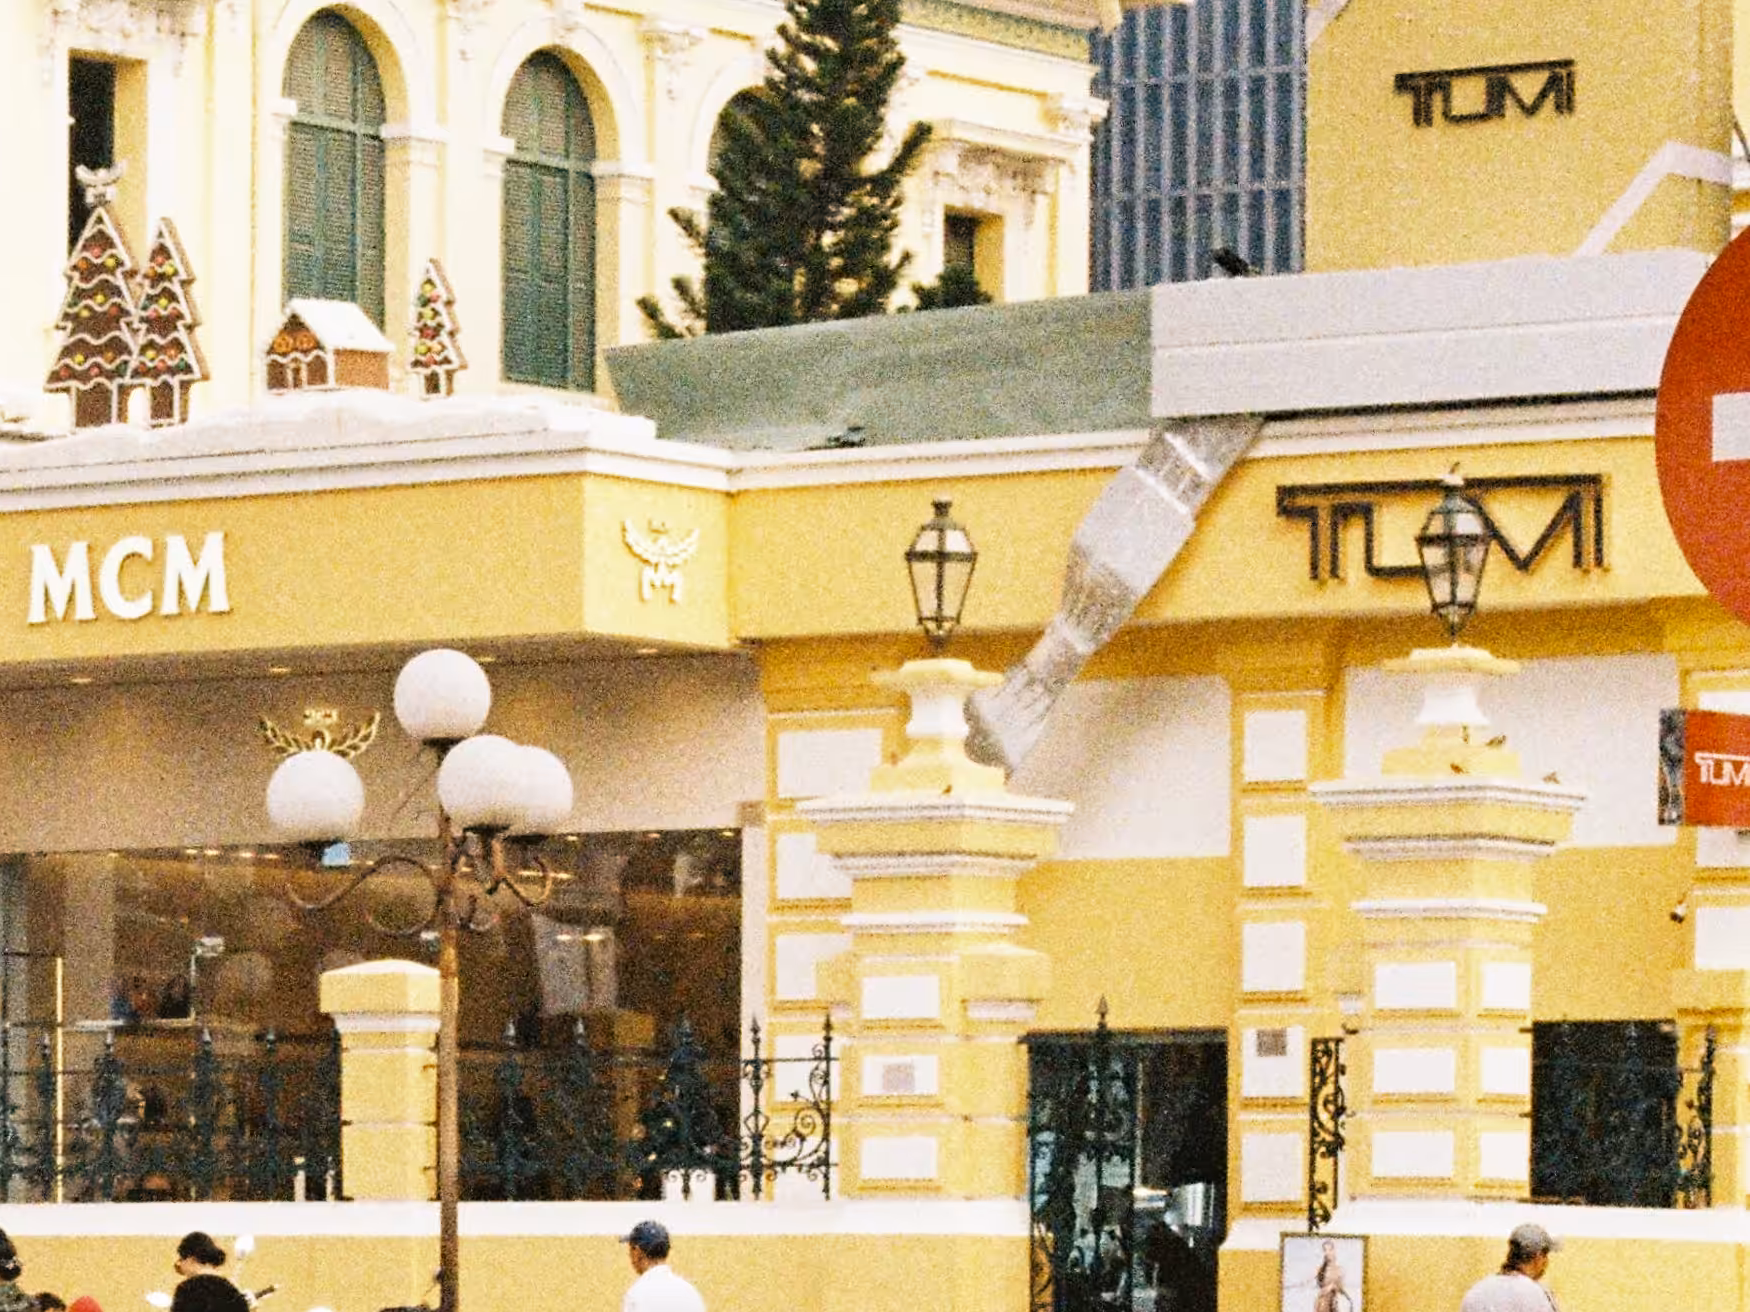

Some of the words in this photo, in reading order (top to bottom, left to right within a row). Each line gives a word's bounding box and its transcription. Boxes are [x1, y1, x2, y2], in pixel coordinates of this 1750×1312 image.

[1394, 58, 1575, 127] TUMI
[1276, 473, 1604, 581] TUMI
[27, 530, 231, 625] MCM
